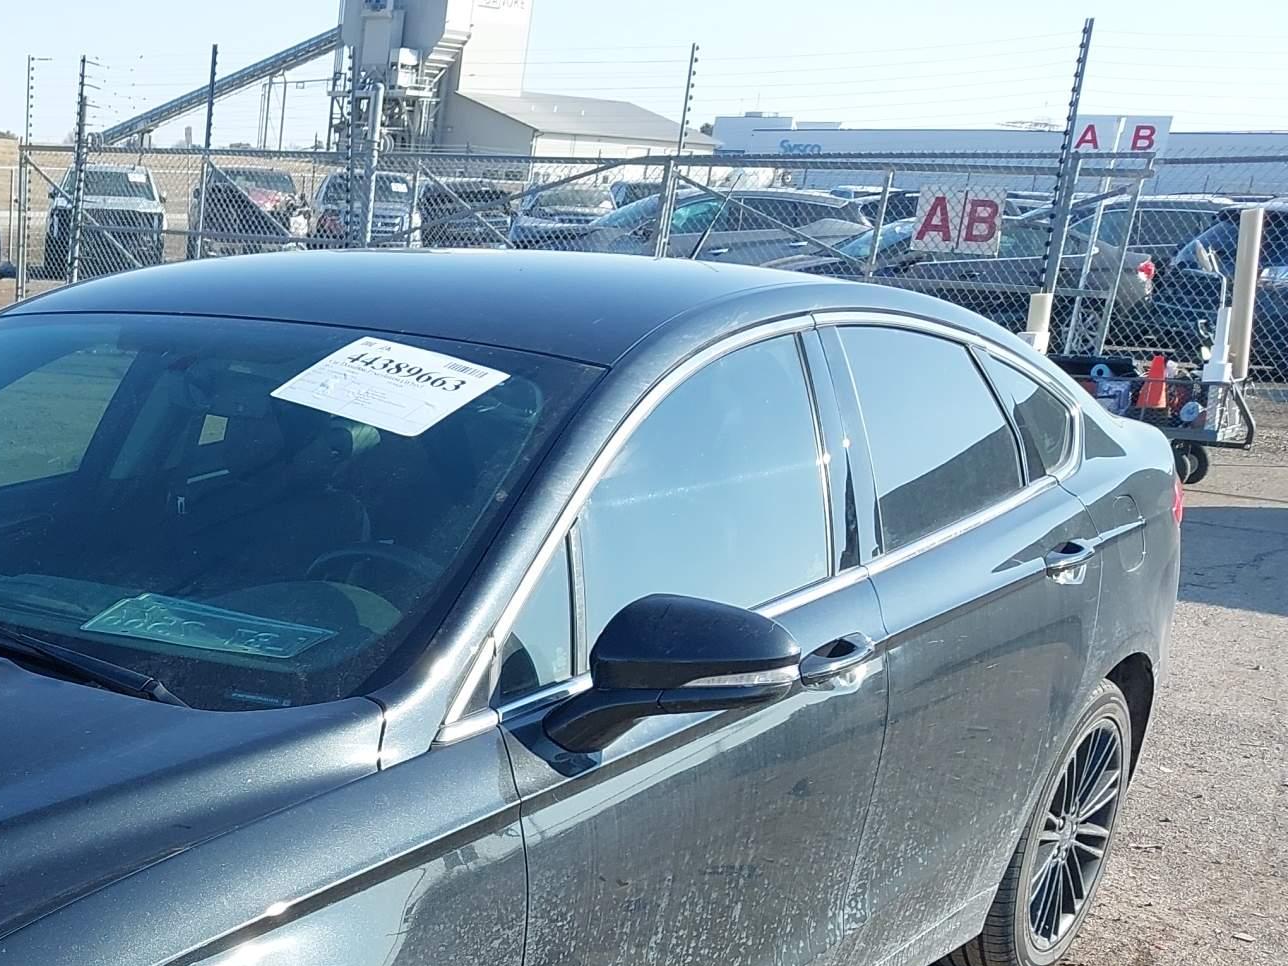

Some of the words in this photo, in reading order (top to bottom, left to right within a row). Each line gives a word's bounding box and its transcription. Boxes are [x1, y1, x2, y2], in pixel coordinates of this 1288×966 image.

[1074, 123, 1099, 150] A
[1130, 124, 1157, 151] B
[346, 352, 466, 392] 44389663
